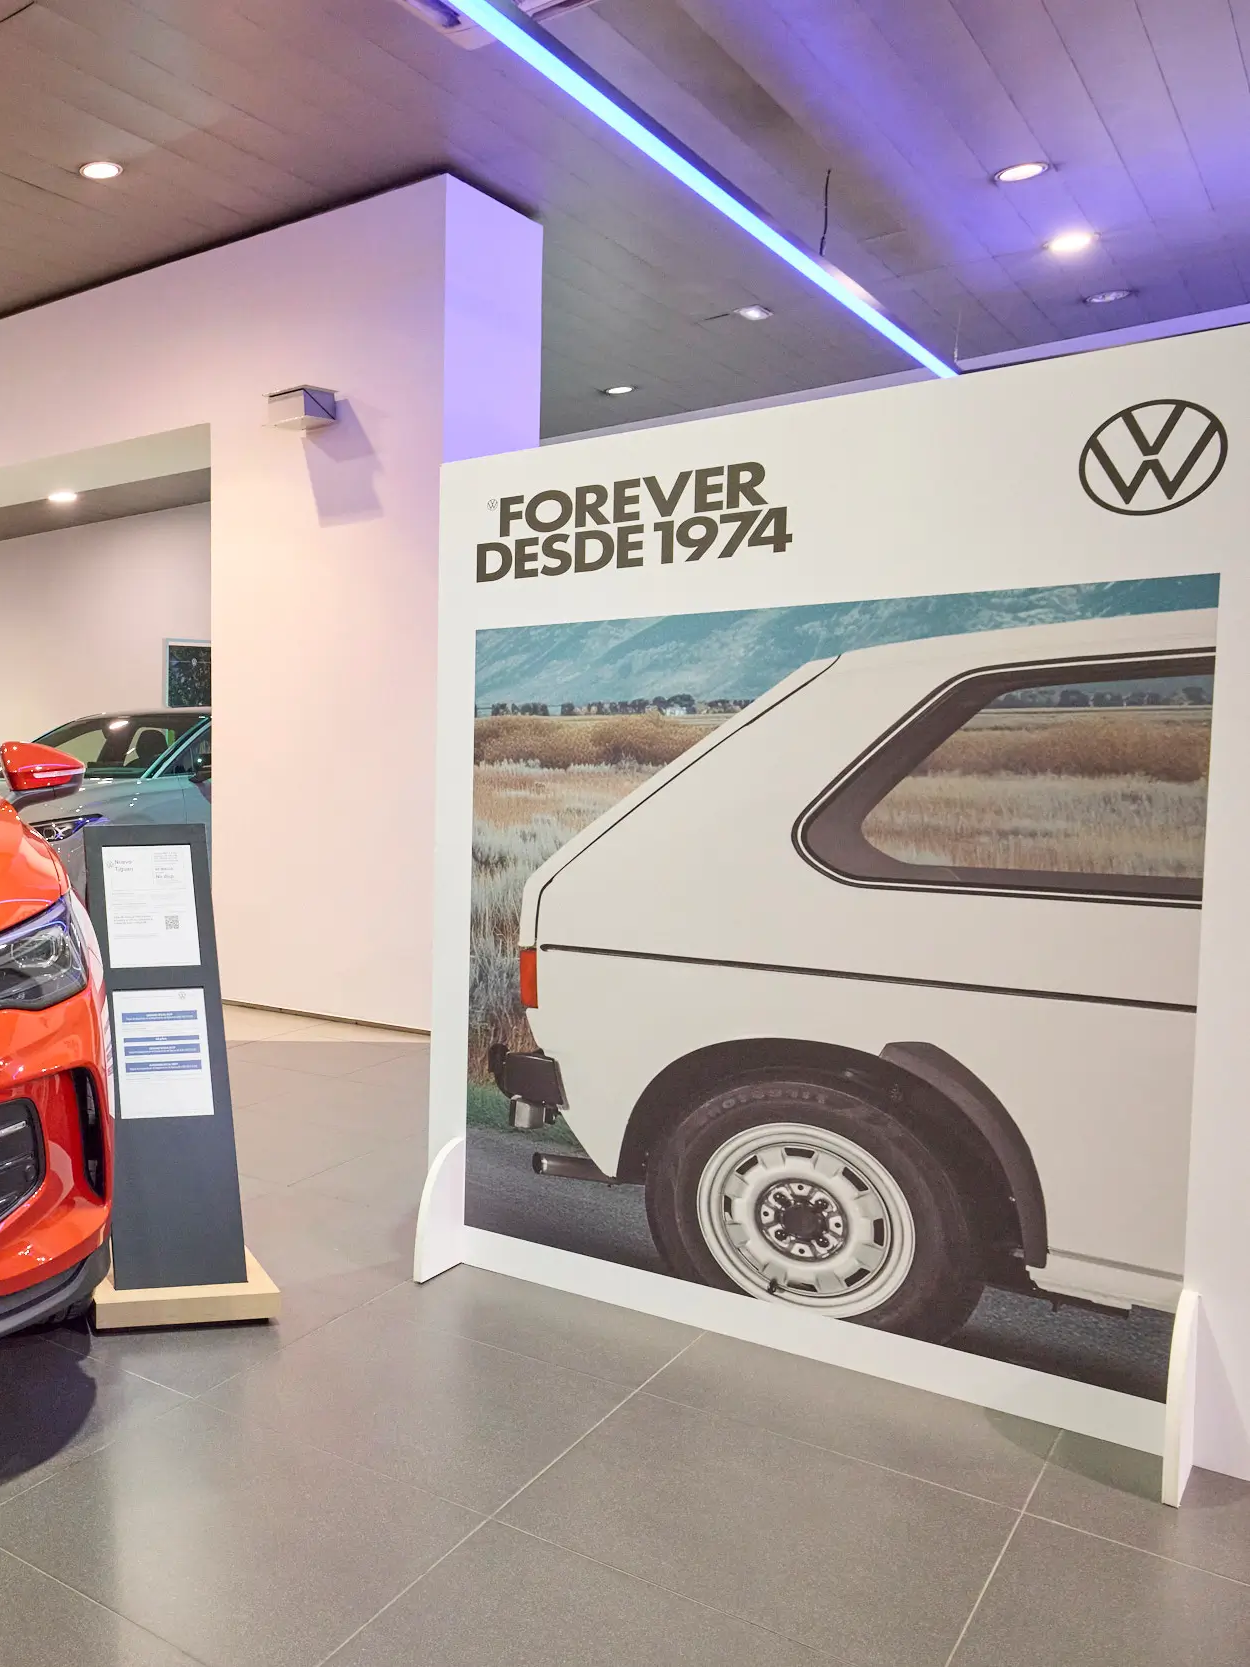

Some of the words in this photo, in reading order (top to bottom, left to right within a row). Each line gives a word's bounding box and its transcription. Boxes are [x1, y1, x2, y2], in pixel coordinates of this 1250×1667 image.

[1079, 399, 1228, 516] VW
[499, 461, 769, 537] FOREVER
[476, 524, 644, 583] DESDE
[653, 506, 793, 565] 1974
